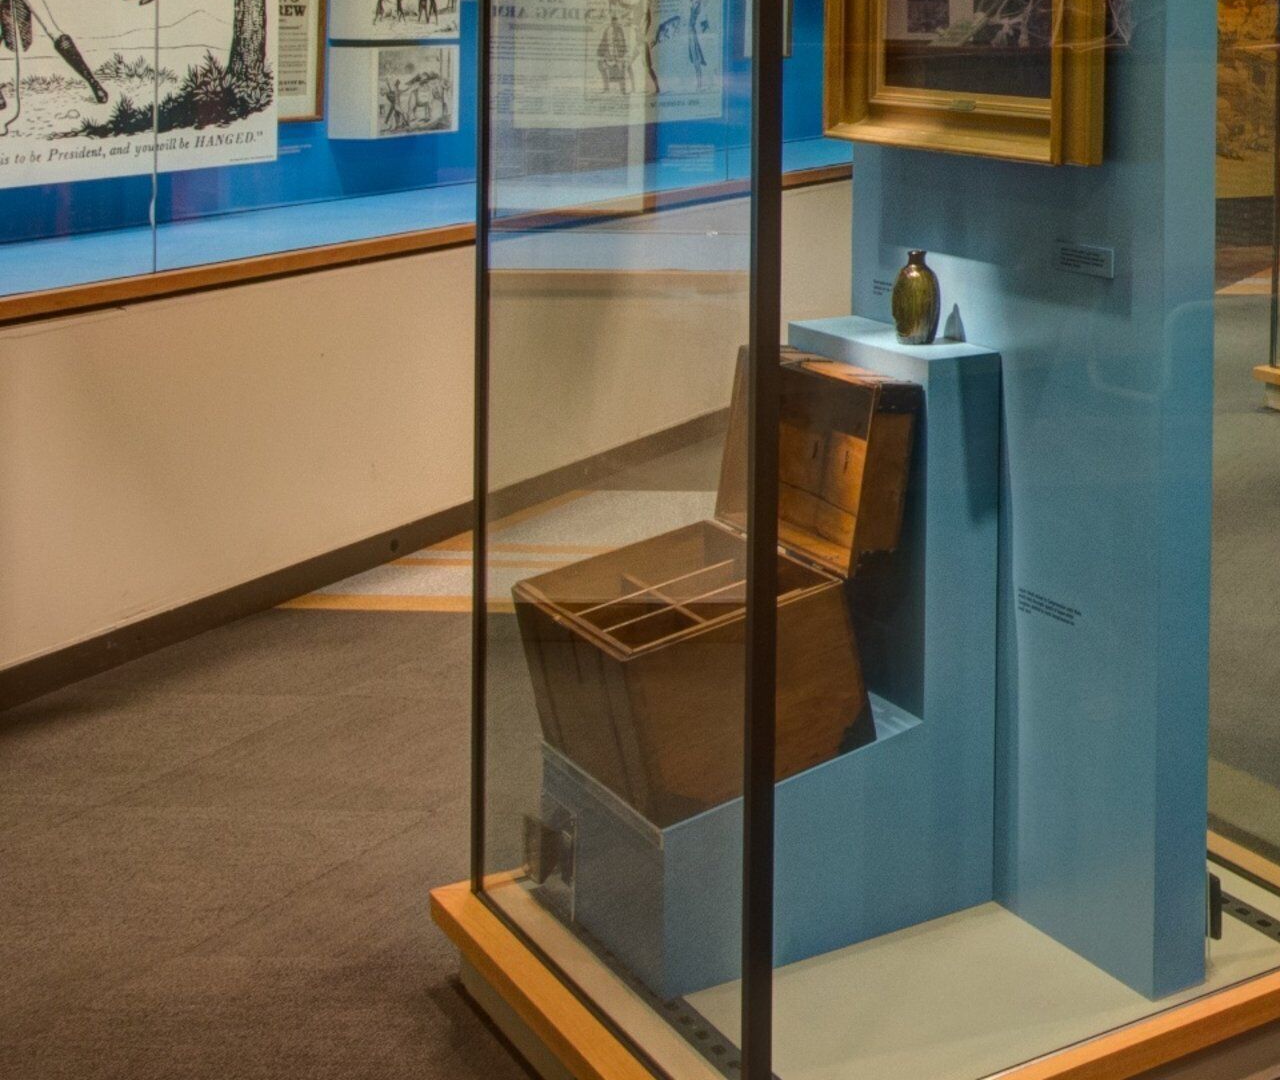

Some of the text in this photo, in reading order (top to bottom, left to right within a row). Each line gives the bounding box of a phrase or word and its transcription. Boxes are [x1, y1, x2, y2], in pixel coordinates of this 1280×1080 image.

[14, 151, 27, 164] to
[29, 148, 42, 163] be
[47, 144, 107, 162] President,
[109, 141, 131, 156] and
[134, 143, 155, 159] you
[178, 136, 190, 150] be
[194, 130, 264, 149] HANGED.”
